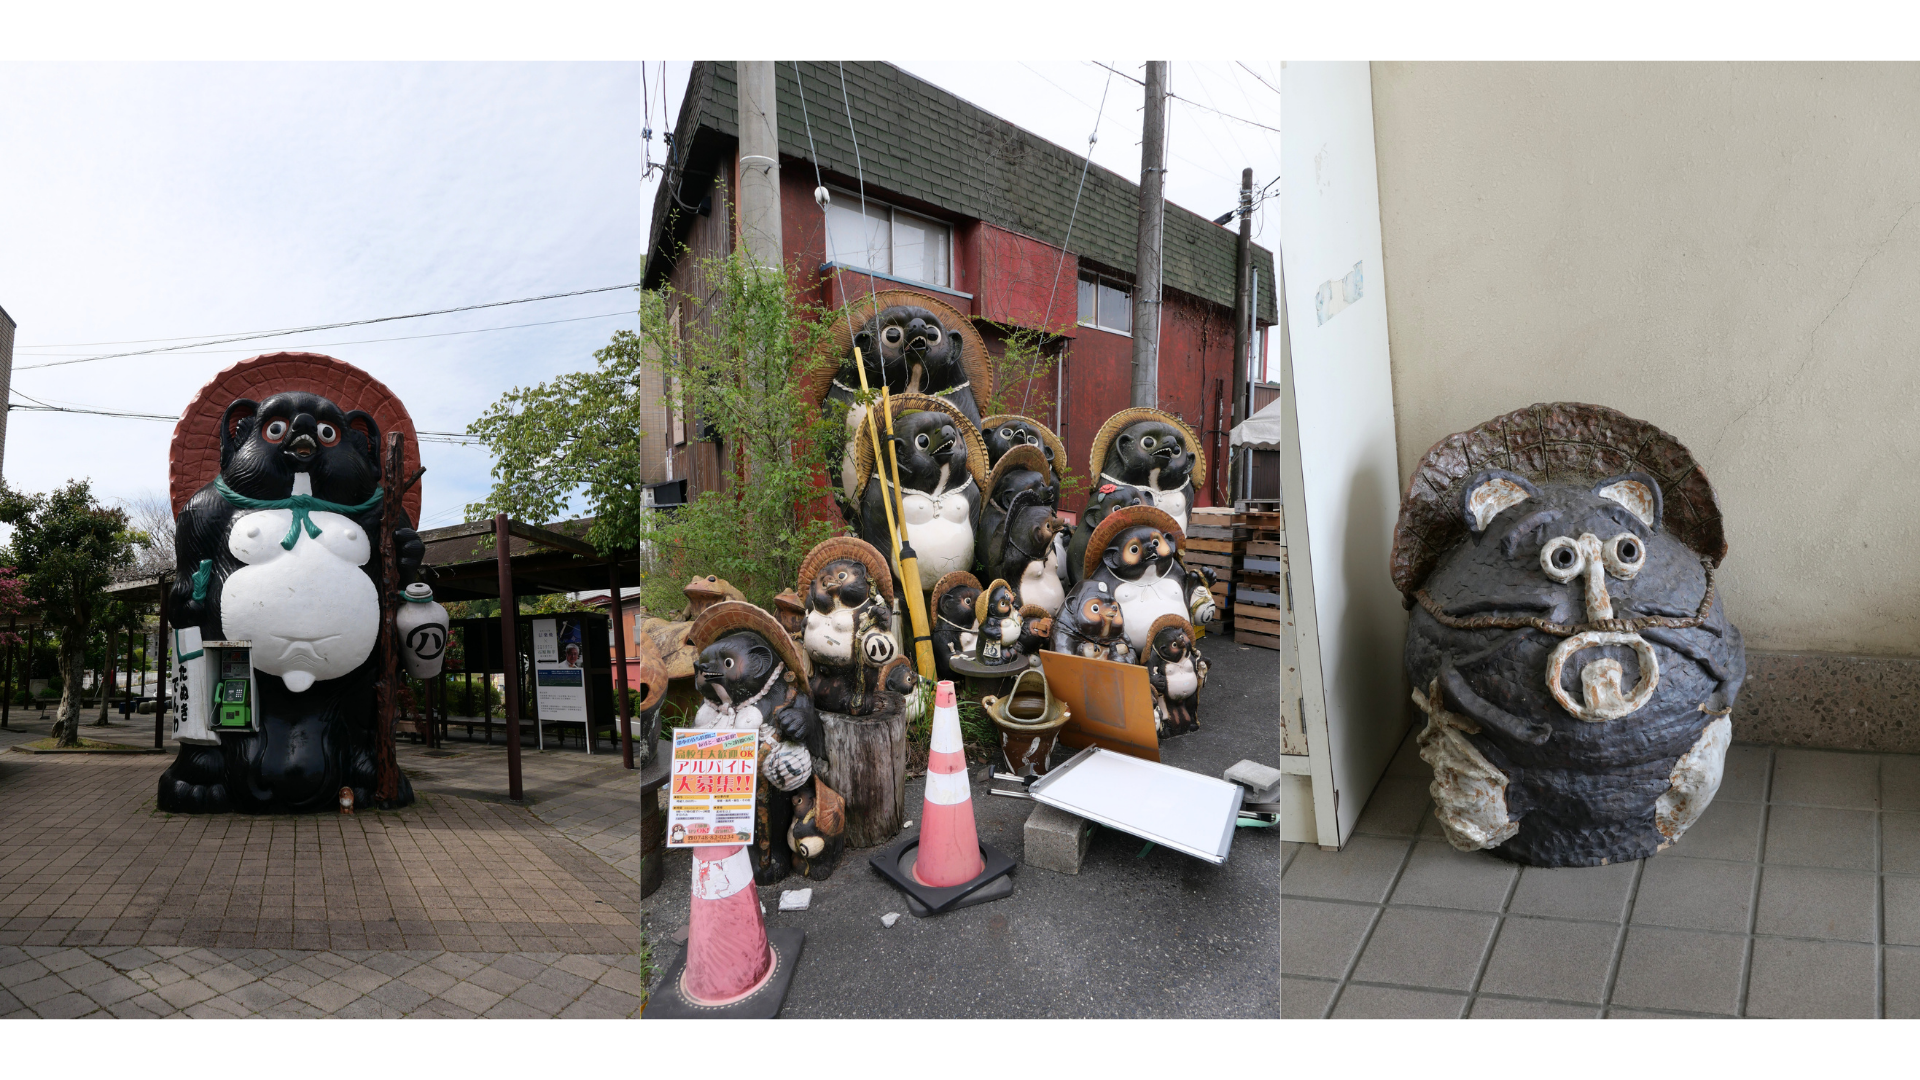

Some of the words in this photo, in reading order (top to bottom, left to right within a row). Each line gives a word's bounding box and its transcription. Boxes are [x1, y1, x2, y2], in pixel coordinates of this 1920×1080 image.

[179, 665, 189, 722] たぬき
[675, 749, 738, 759] 高校生大歓迎
[740, 750, 754, 758] OK
[676, 760, 751, 773] アルバイト
[676, 775, 750, 793] 大募集!!
